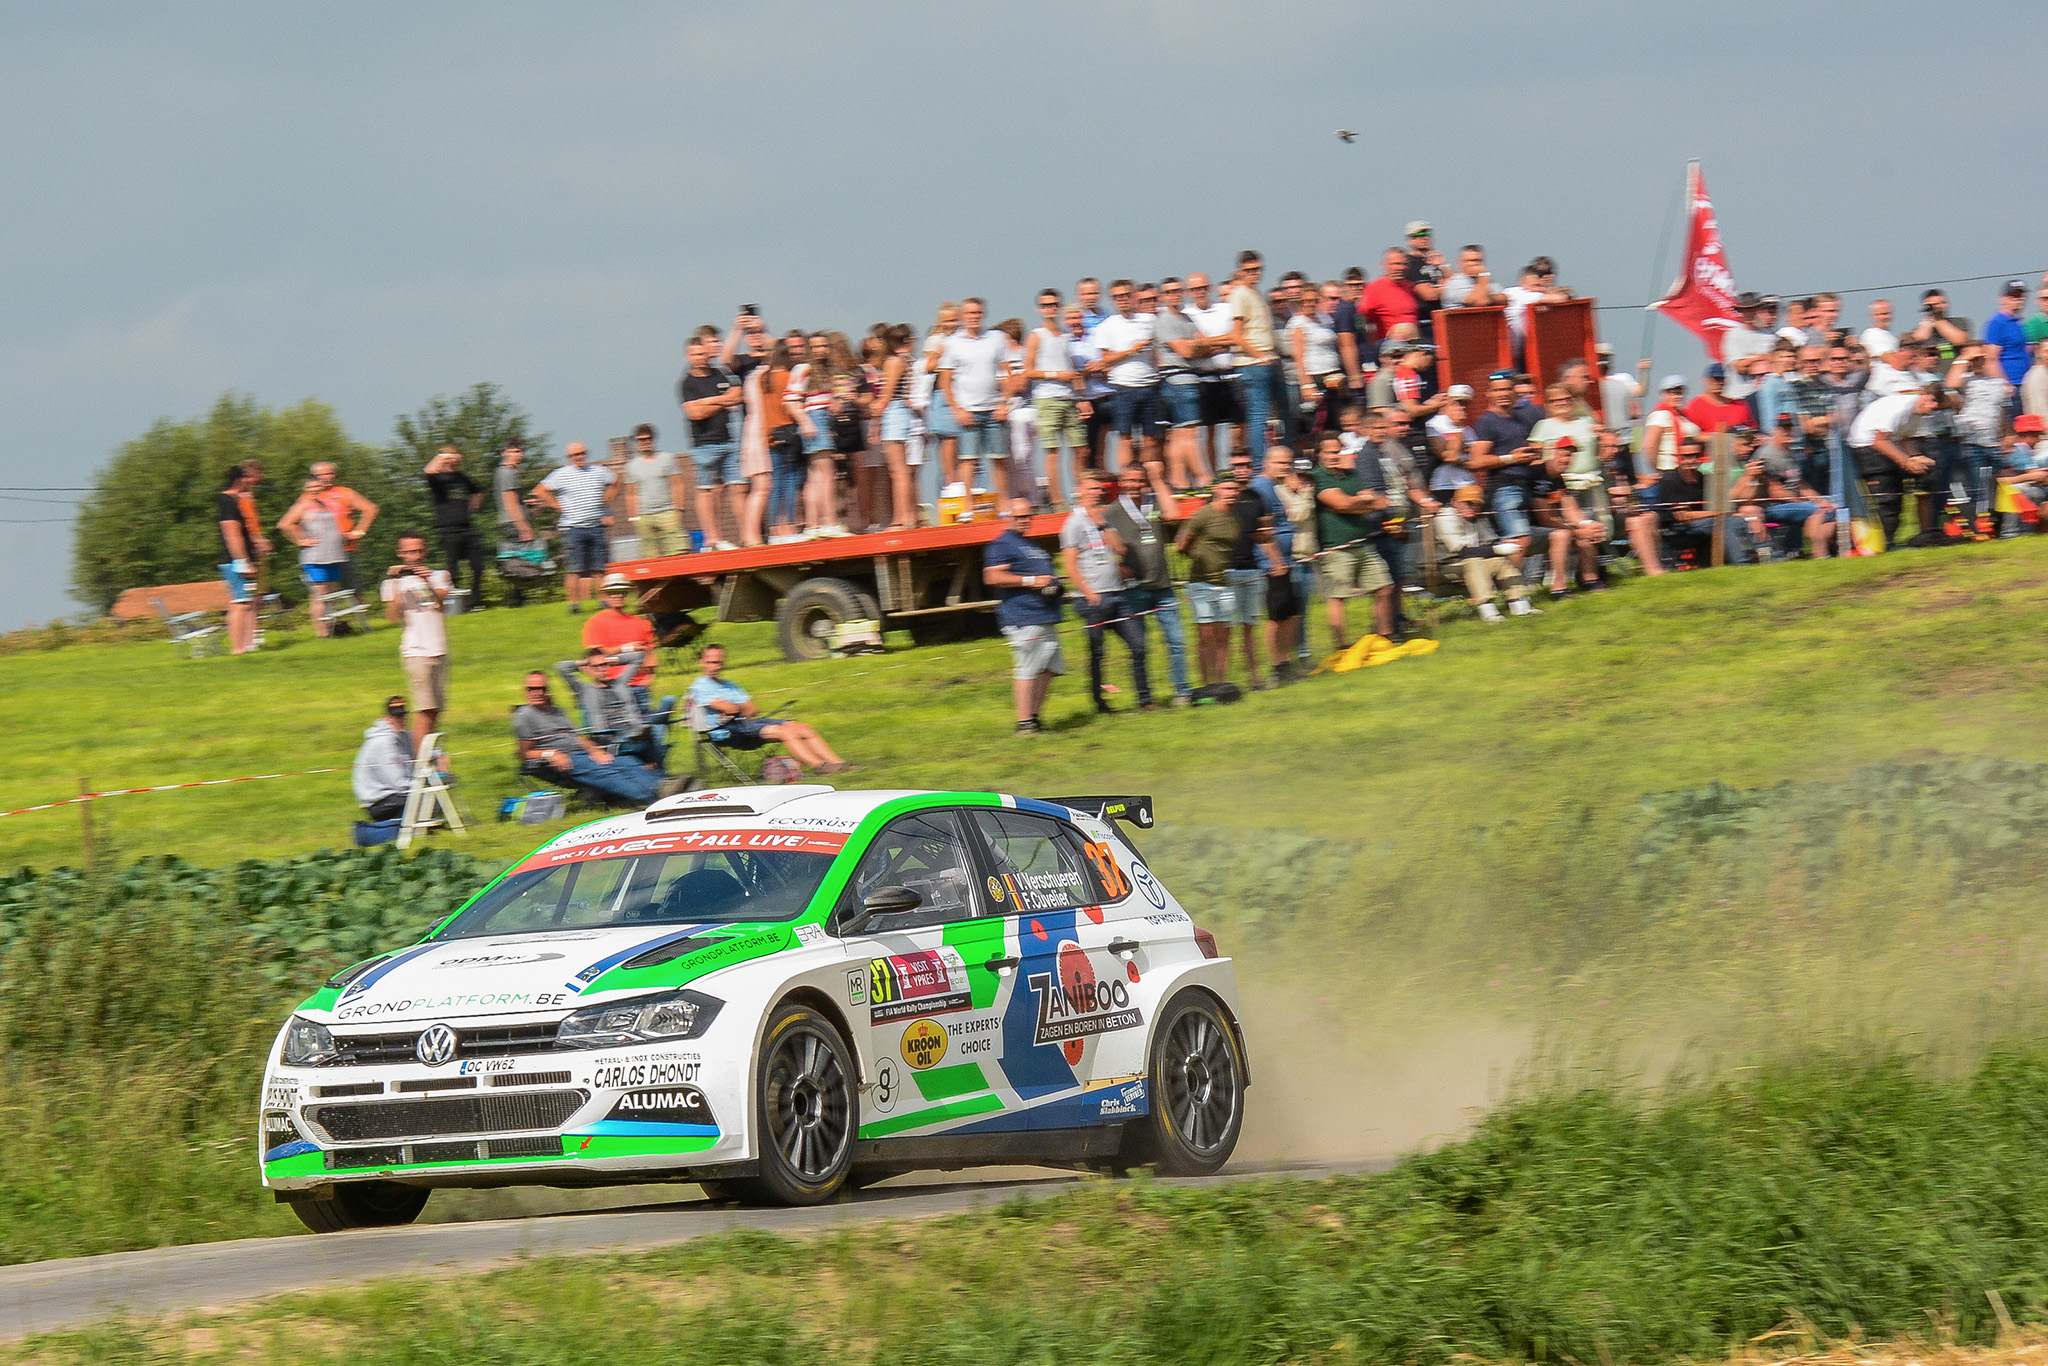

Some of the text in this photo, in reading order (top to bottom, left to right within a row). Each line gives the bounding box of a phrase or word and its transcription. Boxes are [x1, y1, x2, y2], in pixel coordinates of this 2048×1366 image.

[698, 835, 742, 847] ALL
[748, 834, 804, 847] LIVE
[1084, 841, 1129, 898] 37
[1012, 870, 1083, 891] V.Verschueren
[1022, 891, 1071, 910] F.Cuvelier
[1144, 912, 1189, 926] TOP MOTORS
[681, 931, 781, 970] GRONDPLATFORM.BE
[910, 960, 930, 974] VISIT
[850, 976, 863, 992] MR
[870, 958, 893, 1004] 37
[912, 972, 936, 988] YPRES
[337, 993, 567, 1020] GRONDPLATFORM.BE
[885, 1007, 894, 1016] FIA
[893, 1004, 906, 1015] World
[906, 1002, 918, 1013] Rally
[917, 999, 948, 1011] Championship
[1028, 972, 1130, 1030] ZANIBOO
[947, 1023, 963, 1036] THE
[1040, 1012, 1137, 1039] ZAGEN EN BOREN IN BETON
[907, 1035, 941, 1053] KROON
[960, 1038, 991, 1055] CHOICE
[650, 1052, 701, 1061] CONSTRUCTIES
[917, 1050, 932, 1066] OIL
[594, 1063, 701, 1089] CARLOS DHONDT
[618, 1091, 700, 1110] ALUMAC
[1101, 1098, 1120, 1108] Chris
